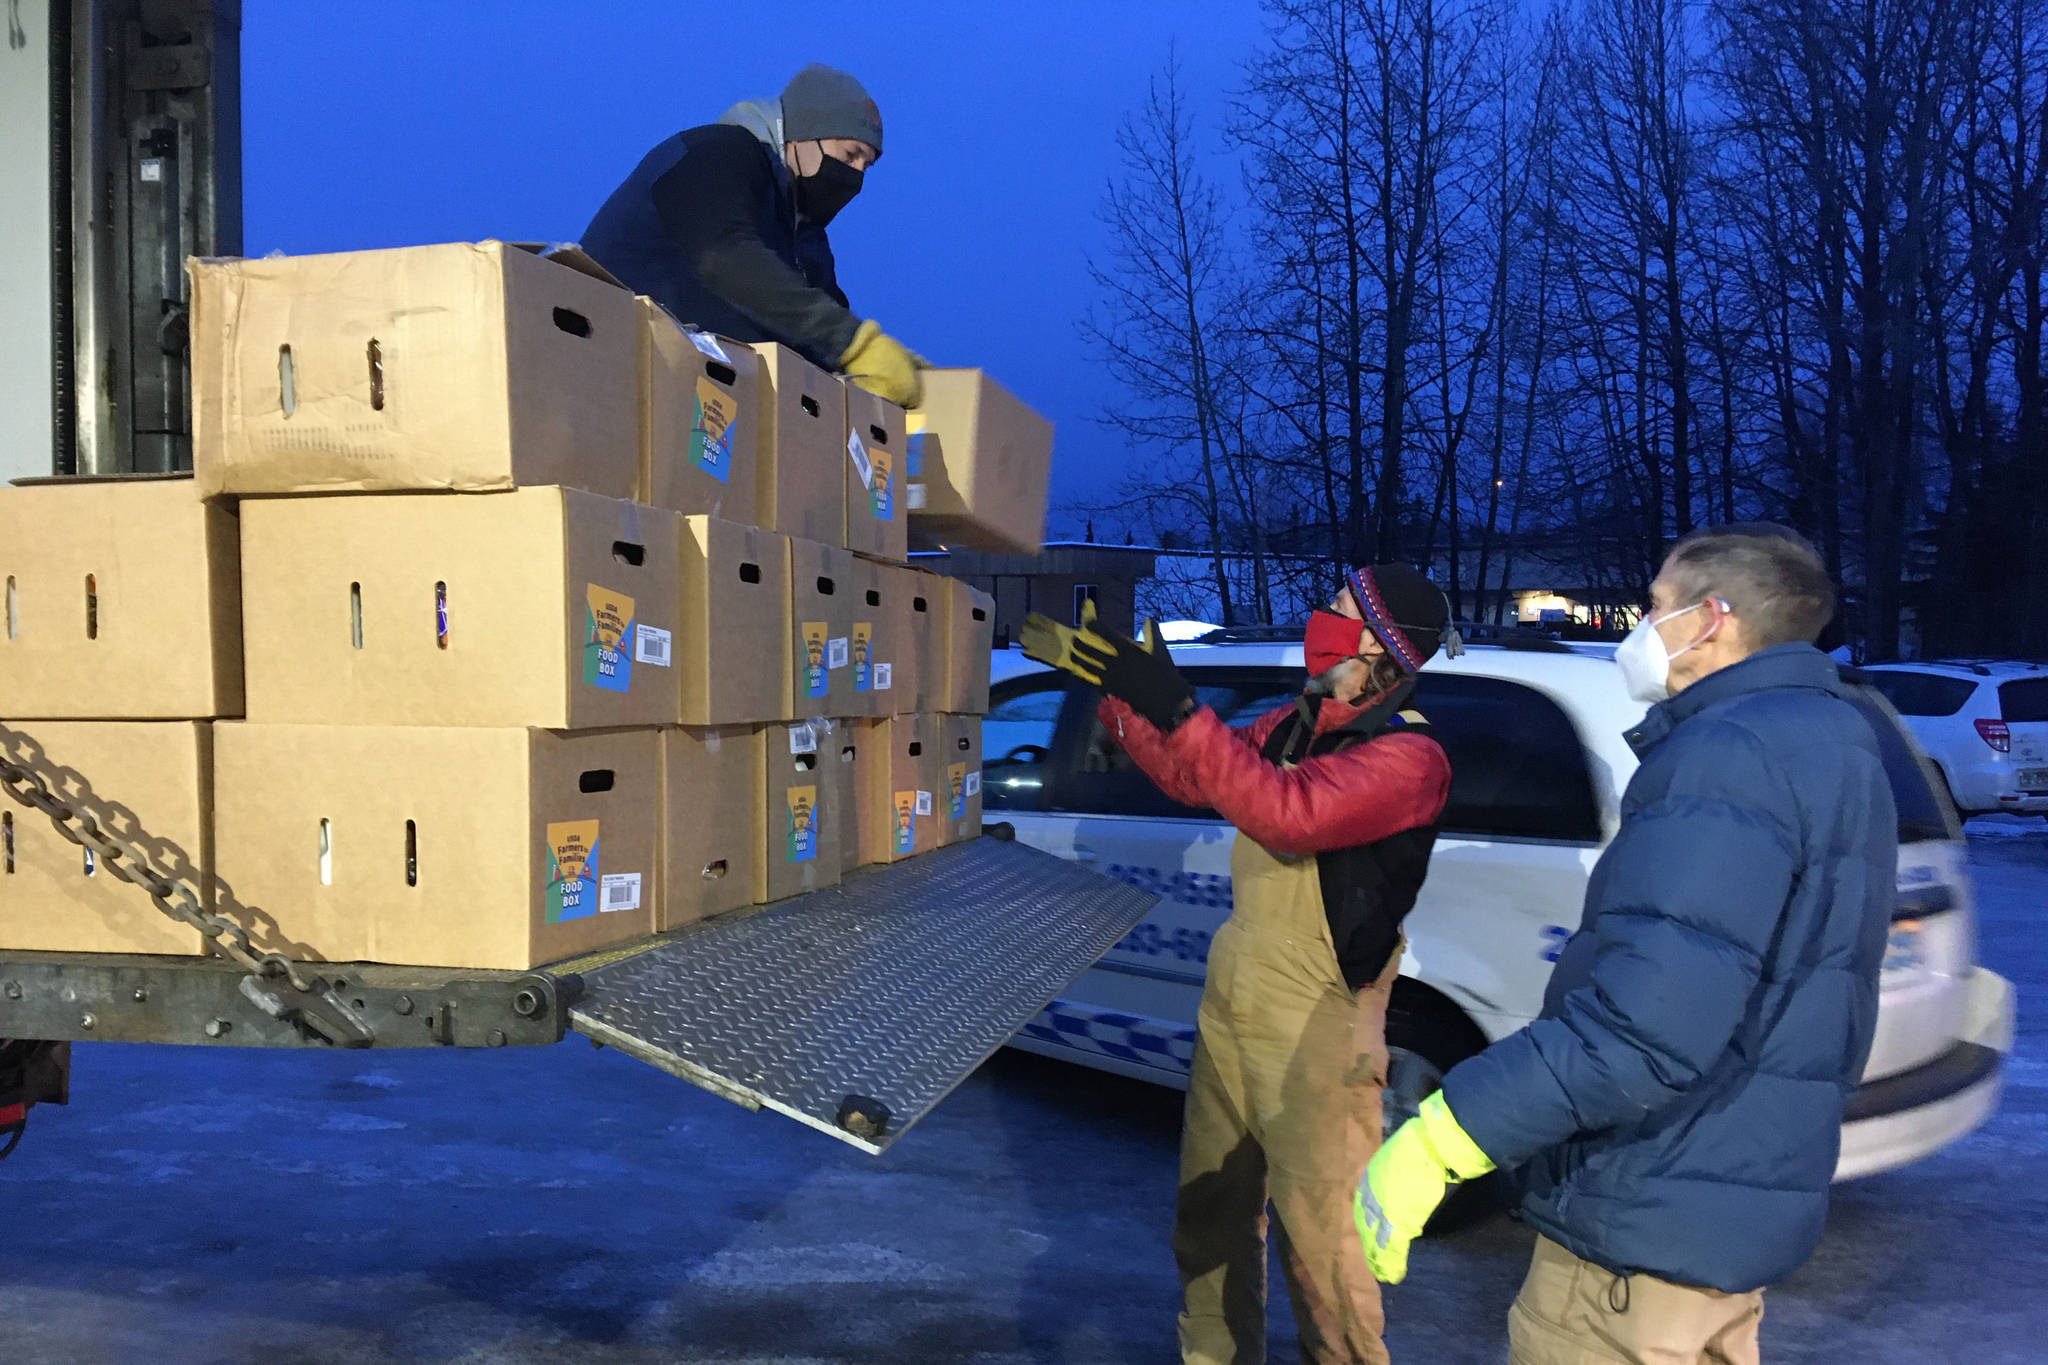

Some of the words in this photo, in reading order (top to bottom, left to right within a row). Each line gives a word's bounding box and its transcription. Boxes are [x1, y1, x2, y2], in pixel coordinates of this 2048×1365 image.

[703, 436, 721, 454] FOOD
[703, 449, 717, 465] BOX
[597, 610, 620, 624] Farmers
[598, 621, 621, 635] Families
[598, 649, 618, 663] FOOD
[600, 663, 615, 676] BOX
[558, 845, 583, 855] Farmers
[559, 855, 585, 865] Families
[561, 881, 582, 893] FOOD
[563, 895, 579, 907] BOX
